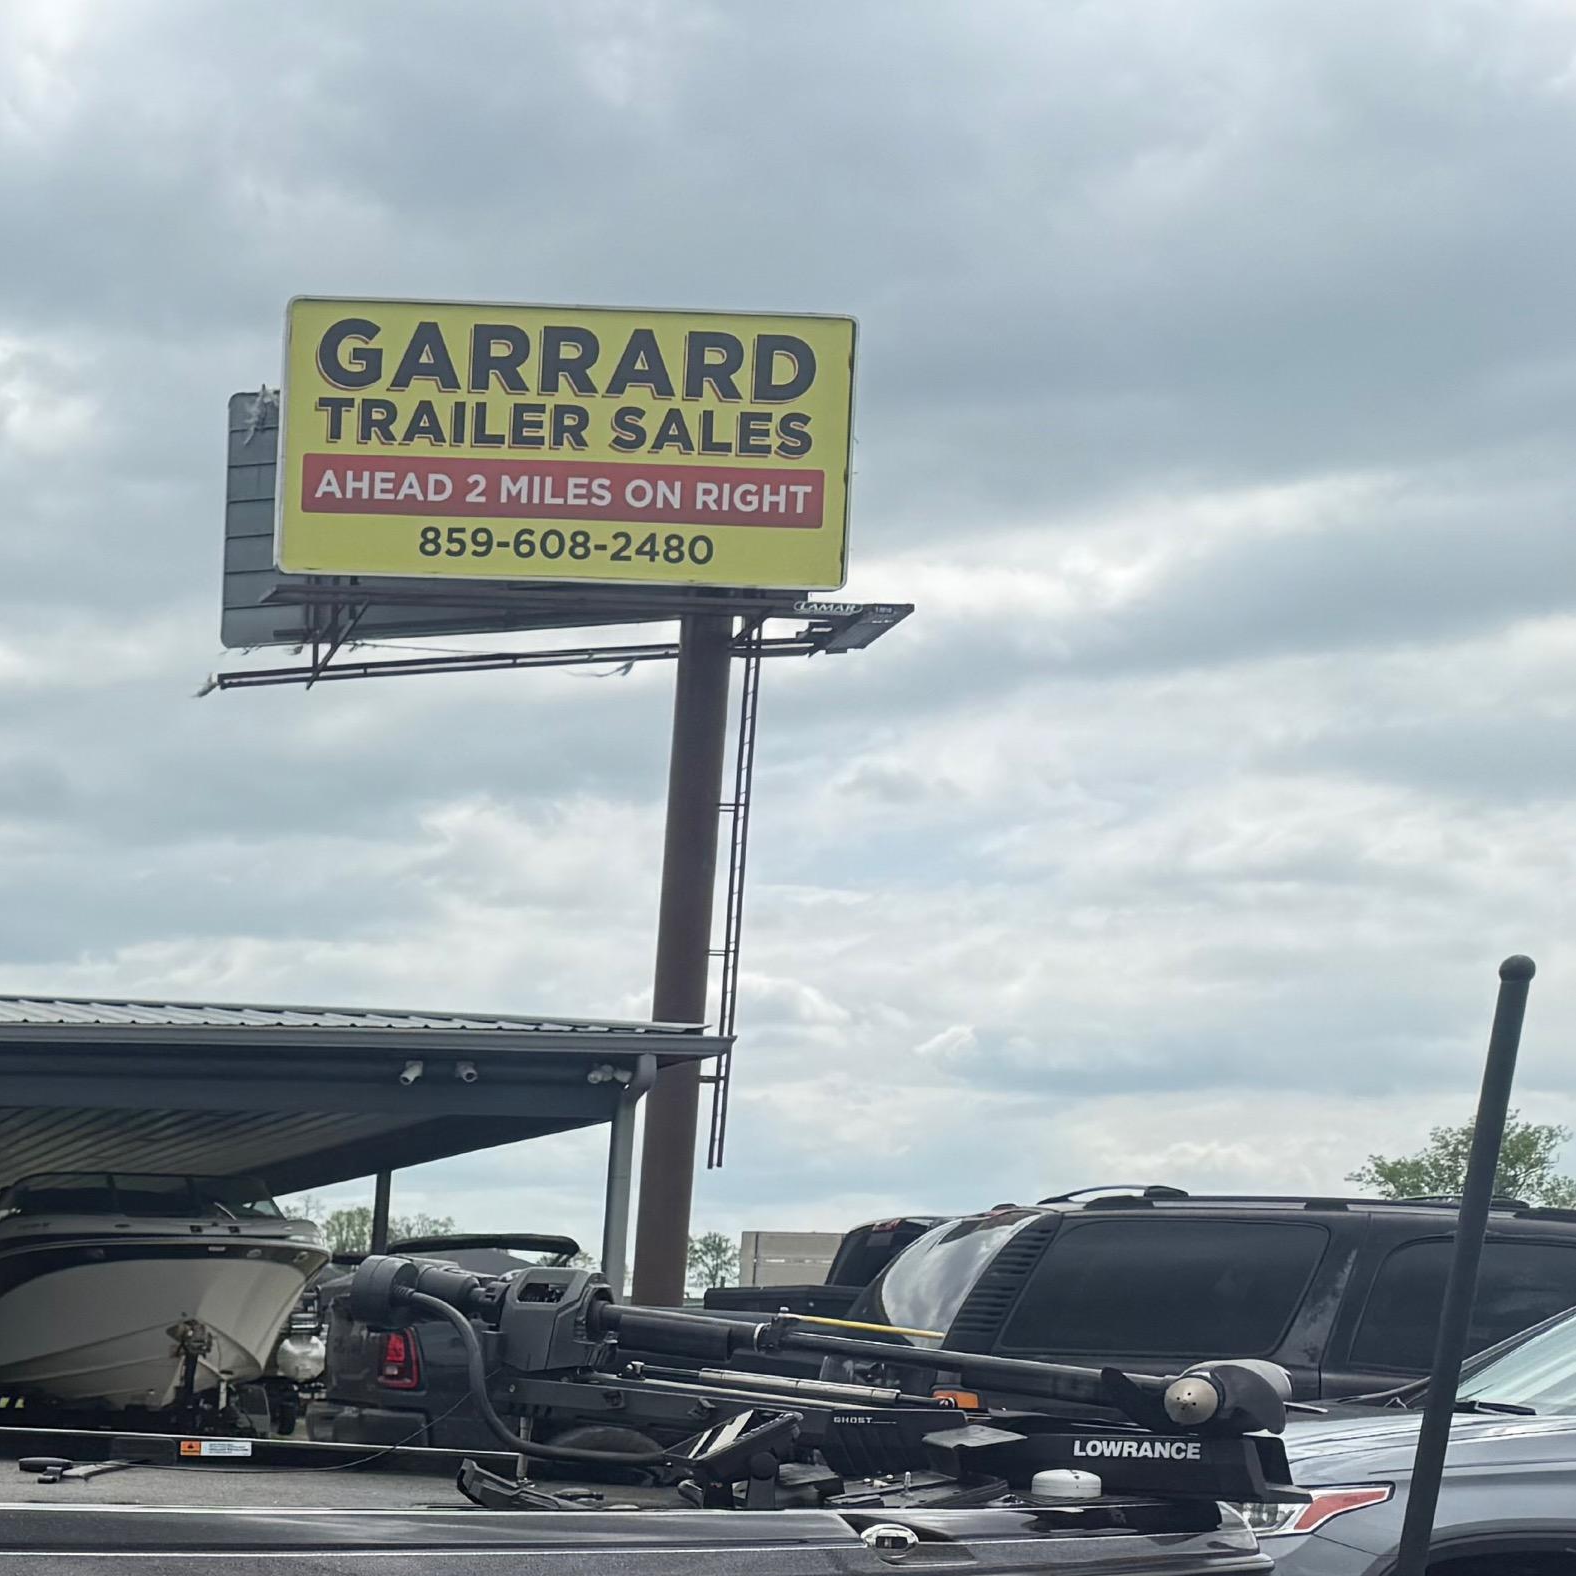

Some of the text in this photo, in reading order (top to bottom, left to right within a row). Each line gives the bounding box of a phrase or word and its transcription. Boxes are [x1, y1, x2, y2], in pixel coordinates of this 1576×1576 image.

[315, 317, 817, 404] GARRARD
[314, 397, 814, 459] TRAILER SALES
[314, 469, 813, 514] AHEAD 2 MILES ON RIGHT
[418, 525, 715, 566] 859-608-2480
[799, 603, 857, 613] LAMAR
[833, 1416, 873, 1424] GHOST
[1073, 1439, 1201, 1460] LOWRANCE
